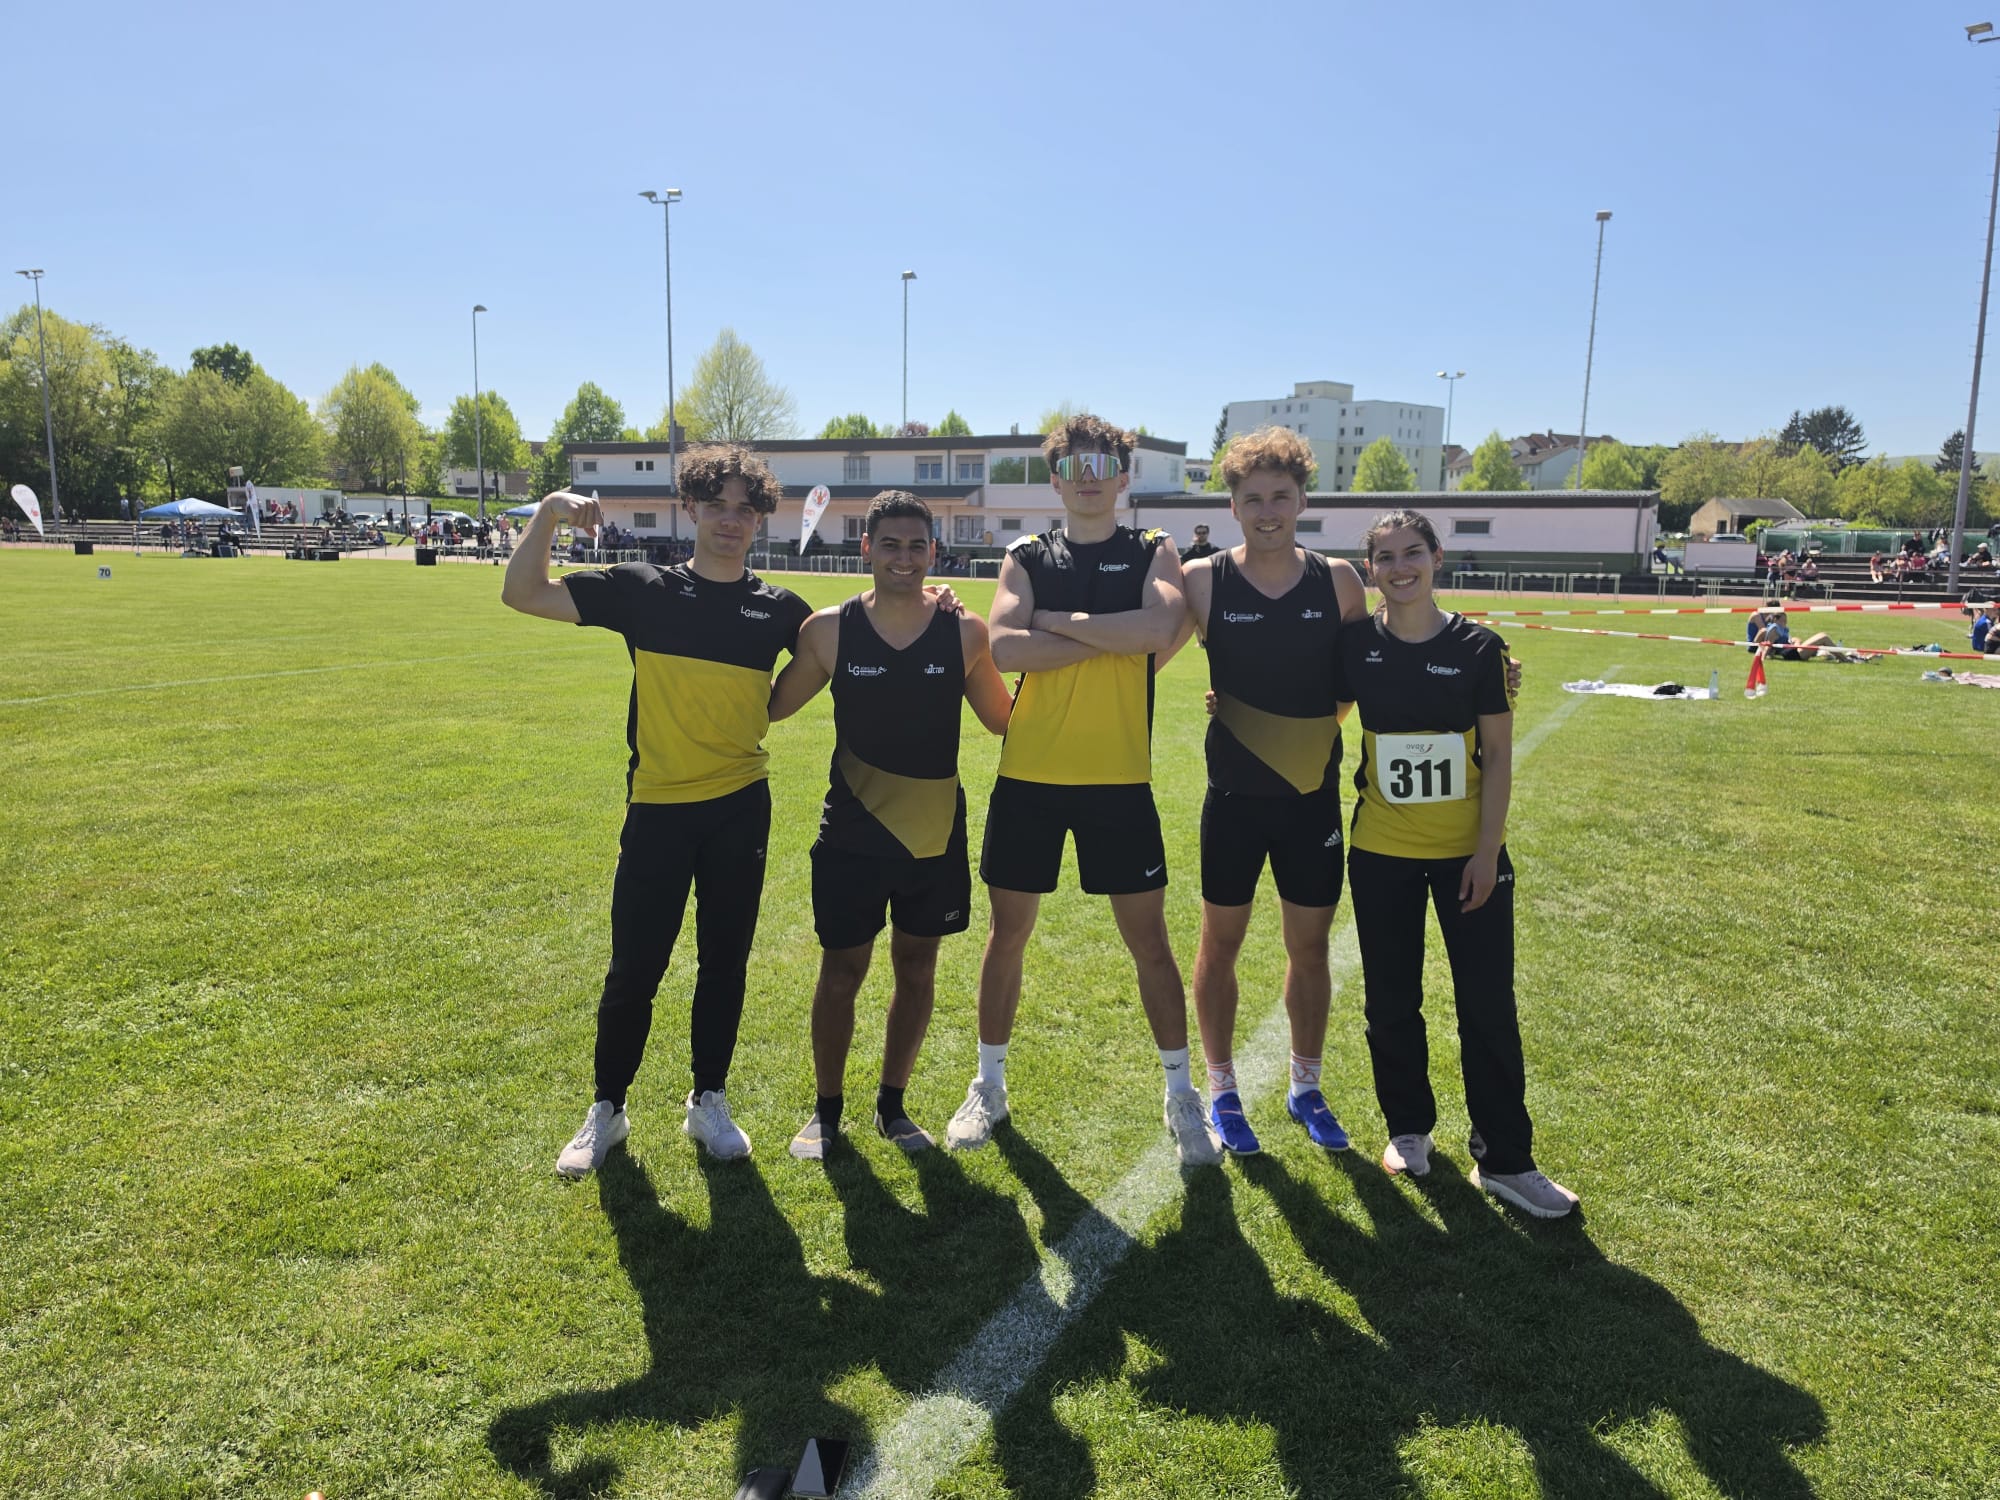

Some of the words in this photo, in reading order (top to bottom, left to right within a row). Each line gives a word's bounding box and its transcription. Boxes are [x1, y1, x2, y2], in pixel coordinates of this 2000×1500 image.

[98, 568, 111, 577] 70
[1223, 610, 1236, 622] LG
[848, 662, 860, 676] LG
[1390, 758, 1452, 799] 311
